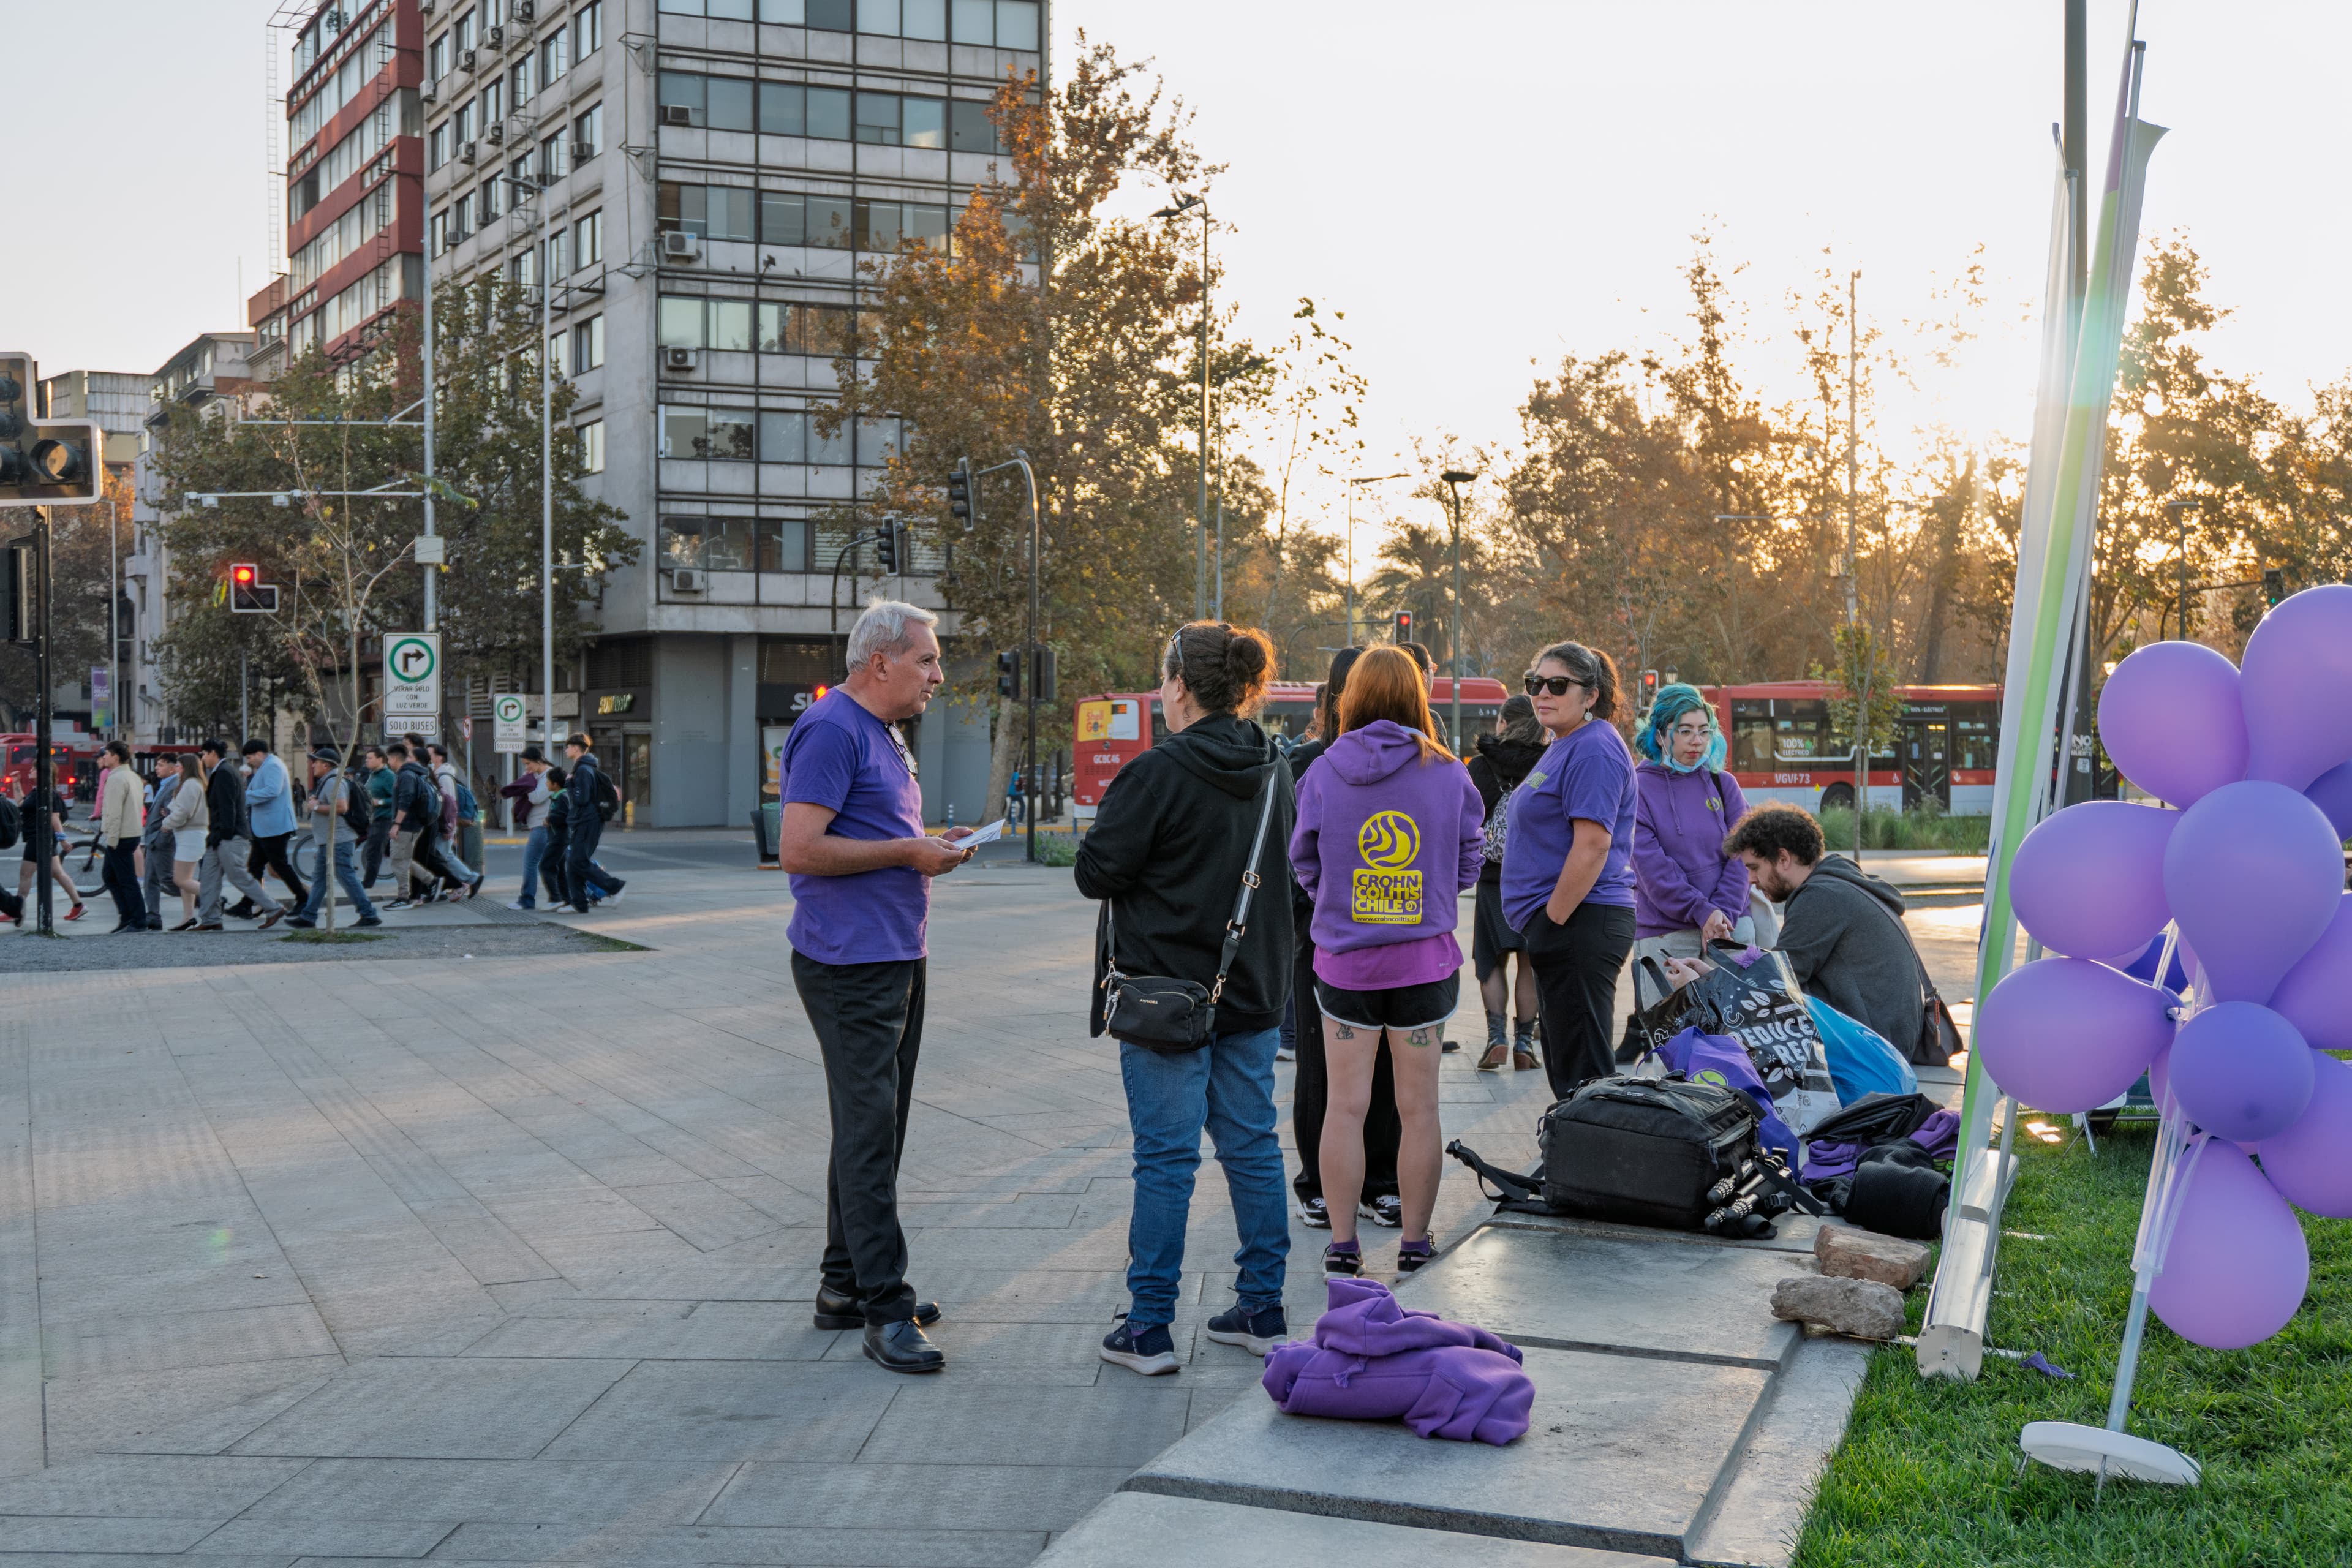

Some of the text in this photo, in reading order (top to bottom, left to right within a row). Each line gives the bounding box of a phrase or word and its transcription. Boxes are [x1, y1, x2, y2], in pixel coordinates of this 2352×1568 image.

[389, 721, 434, 731] SOLO BUSES
[1783, 739, 1804, 748] 100%
[2071, 734, 2092, 747] NO
[1357, 874, 1419, 888] CROHN
[1356, 886, 1420, 900] COLITIS
[1355, 899, 1403, 913] CHILE
